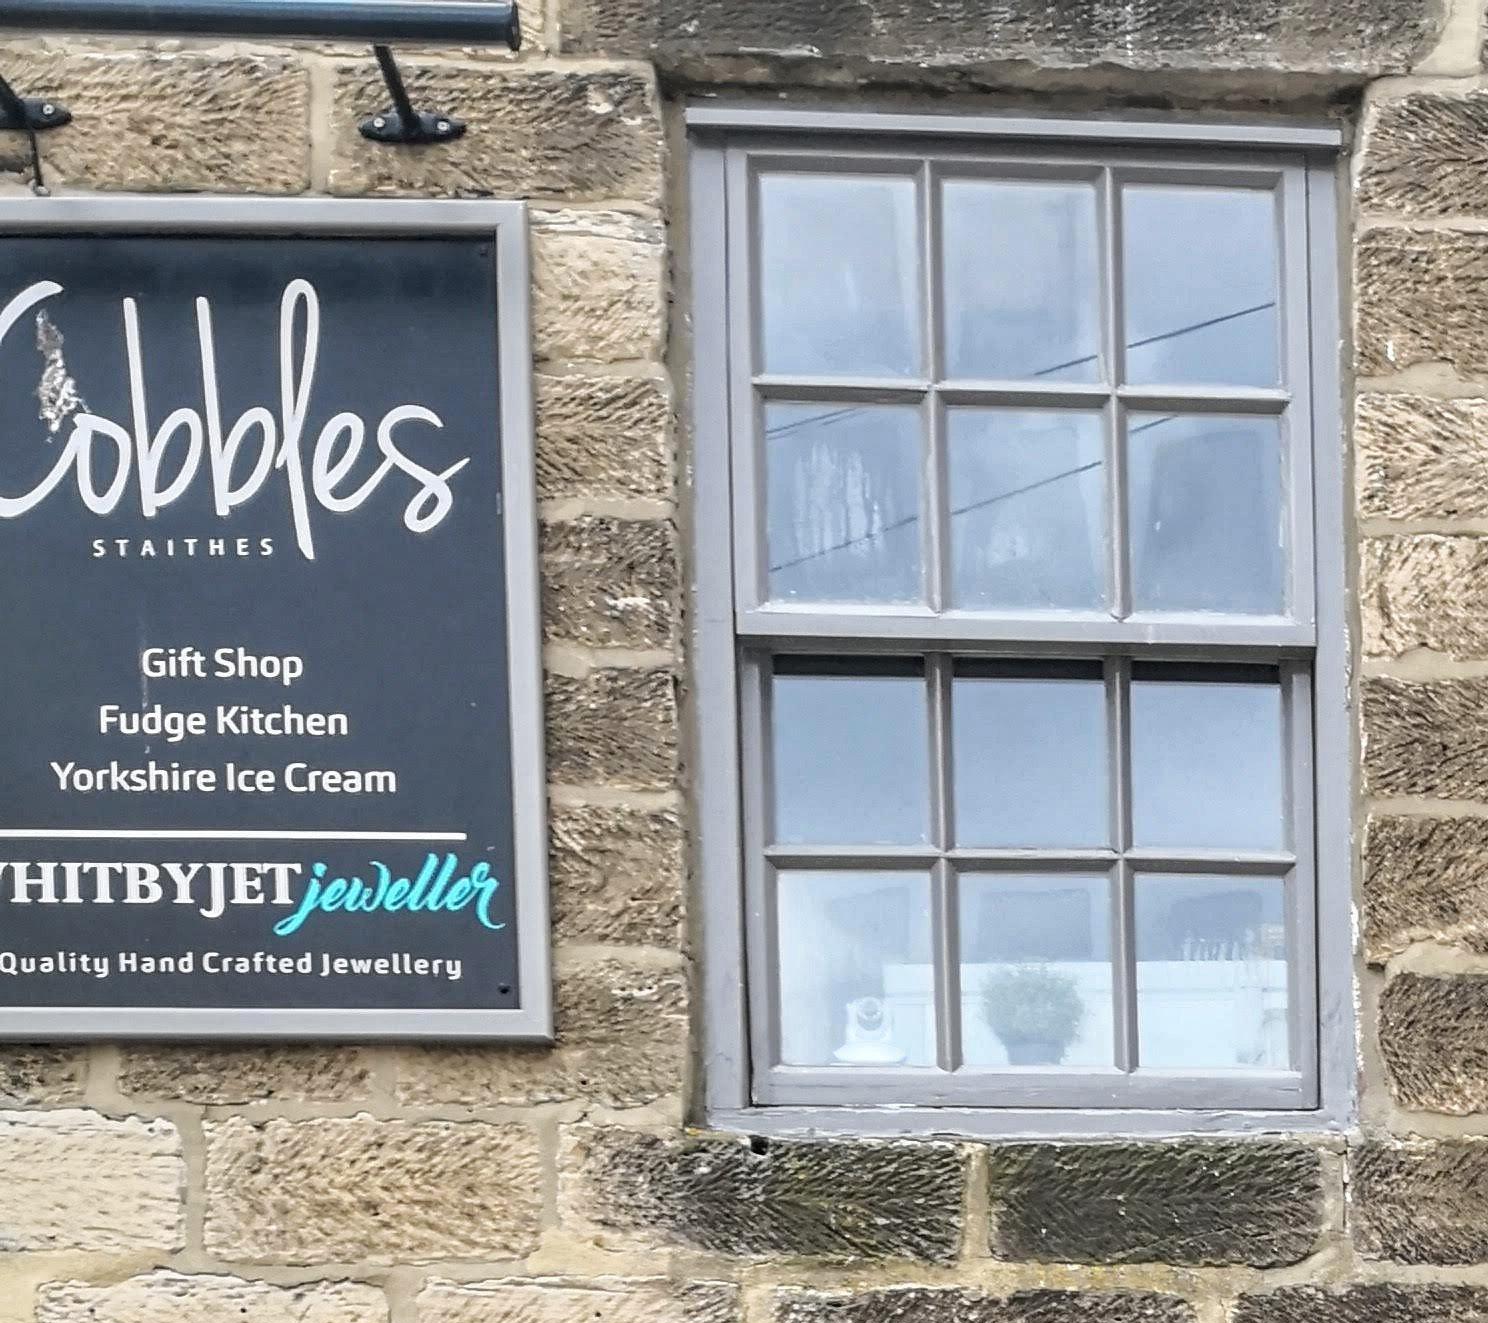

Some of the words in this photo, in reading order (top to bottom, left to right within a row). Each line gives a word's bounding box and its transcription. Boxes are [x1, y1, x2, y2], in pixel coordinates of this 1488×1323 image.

[93, 538, 273, 557] STAITHES
[142, 647, 206, 677] Gift
[215, 647, 303, 685] Shop
[100, 704, 206, 742] Fudge
[217, 704, 347, 735] Kitchen
[51, 762, 216, 792] Yorkshire
[227, 762, 275, 792] Ice
[285, 763, 396, 793] Cream
[0, 861, 301, 917] HITBYJET
[273, 853, 505, 936] jeweller
[0, 951, 108, 978] Quality
[119, 951, 193, 973] Hand
[203, 951, 312, 974] Crafted
[320, 953, 461, 980] Jewellery
